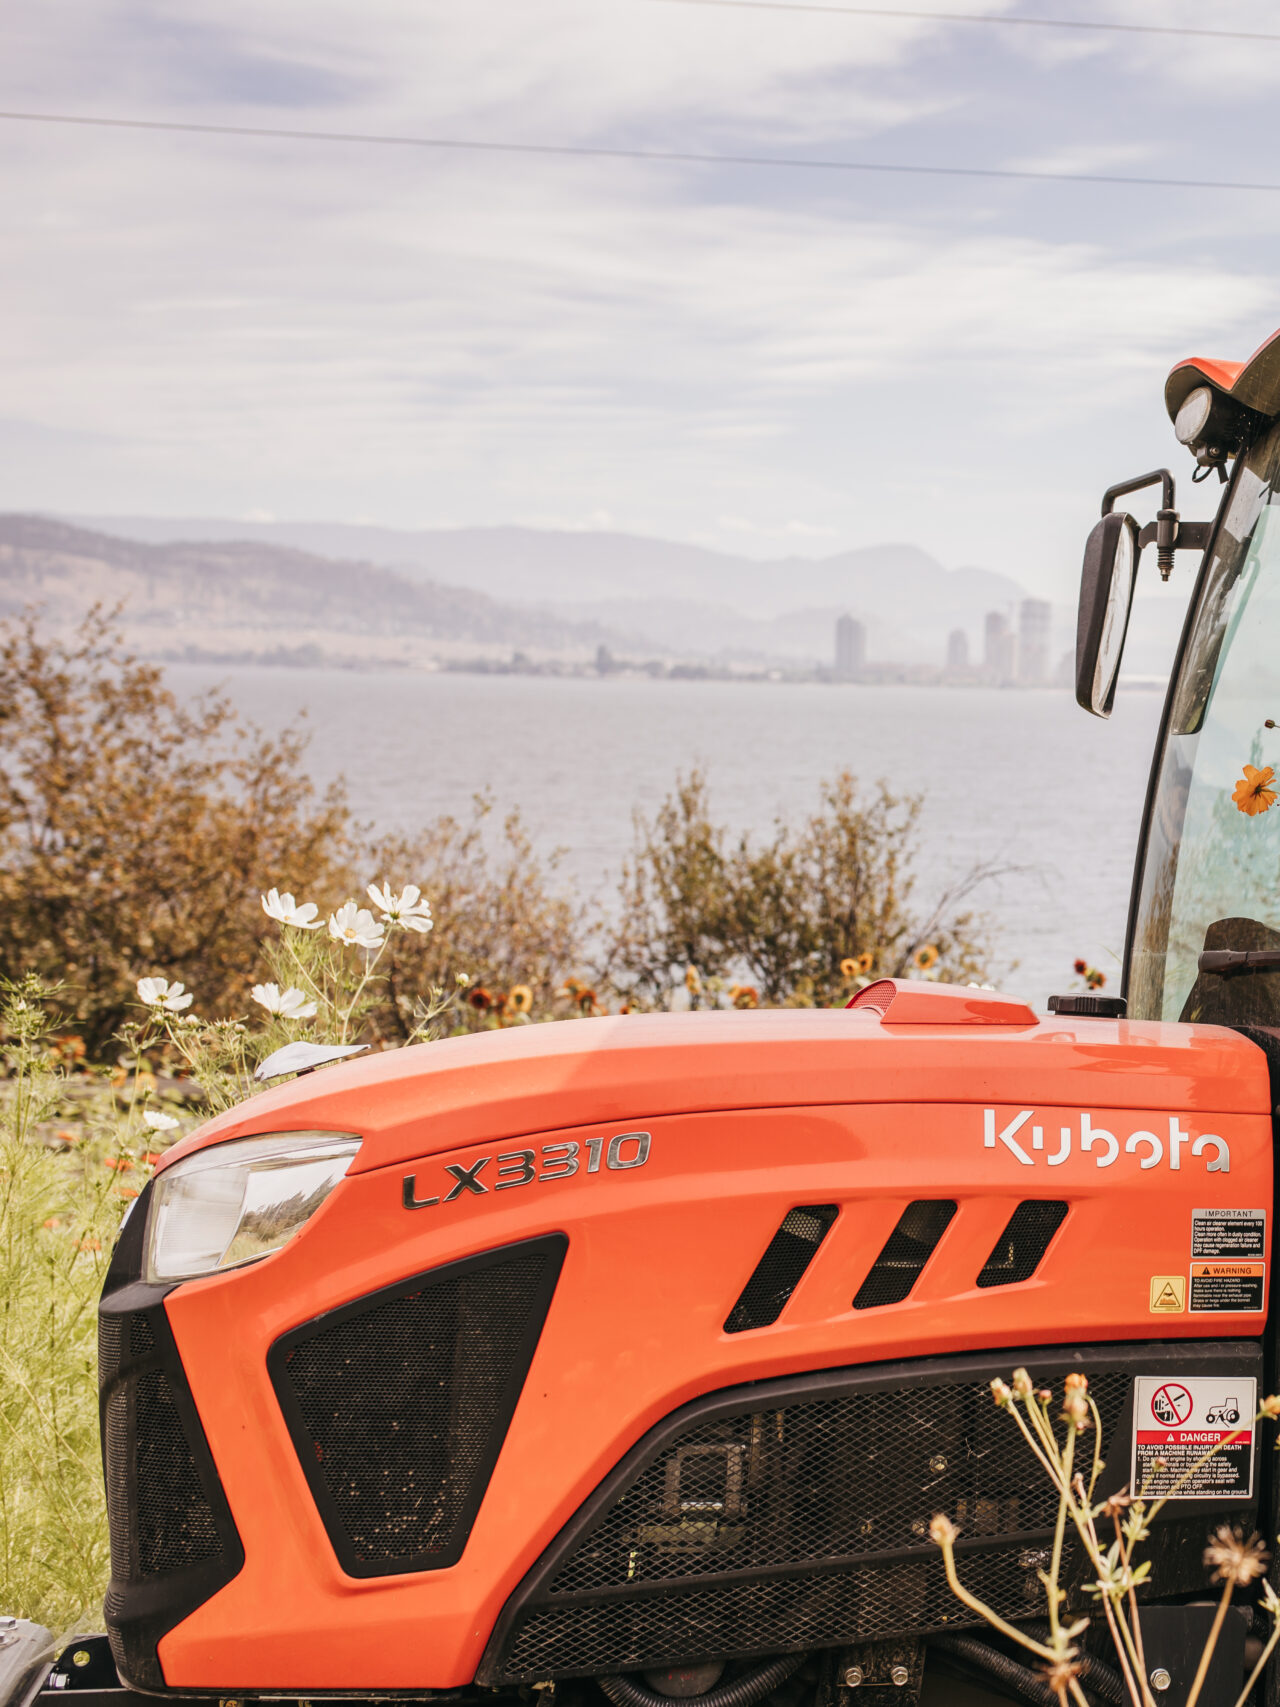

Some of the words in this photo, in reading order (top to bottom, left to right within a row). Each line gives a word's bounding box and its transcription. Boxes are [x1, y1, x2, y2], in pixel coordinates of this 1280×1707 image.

[402, 1132, 652, 1210] LX3310
[984, 1109, 1230, 1172] Kubota
[1180, 1433, 1221, 1442] DANGER
